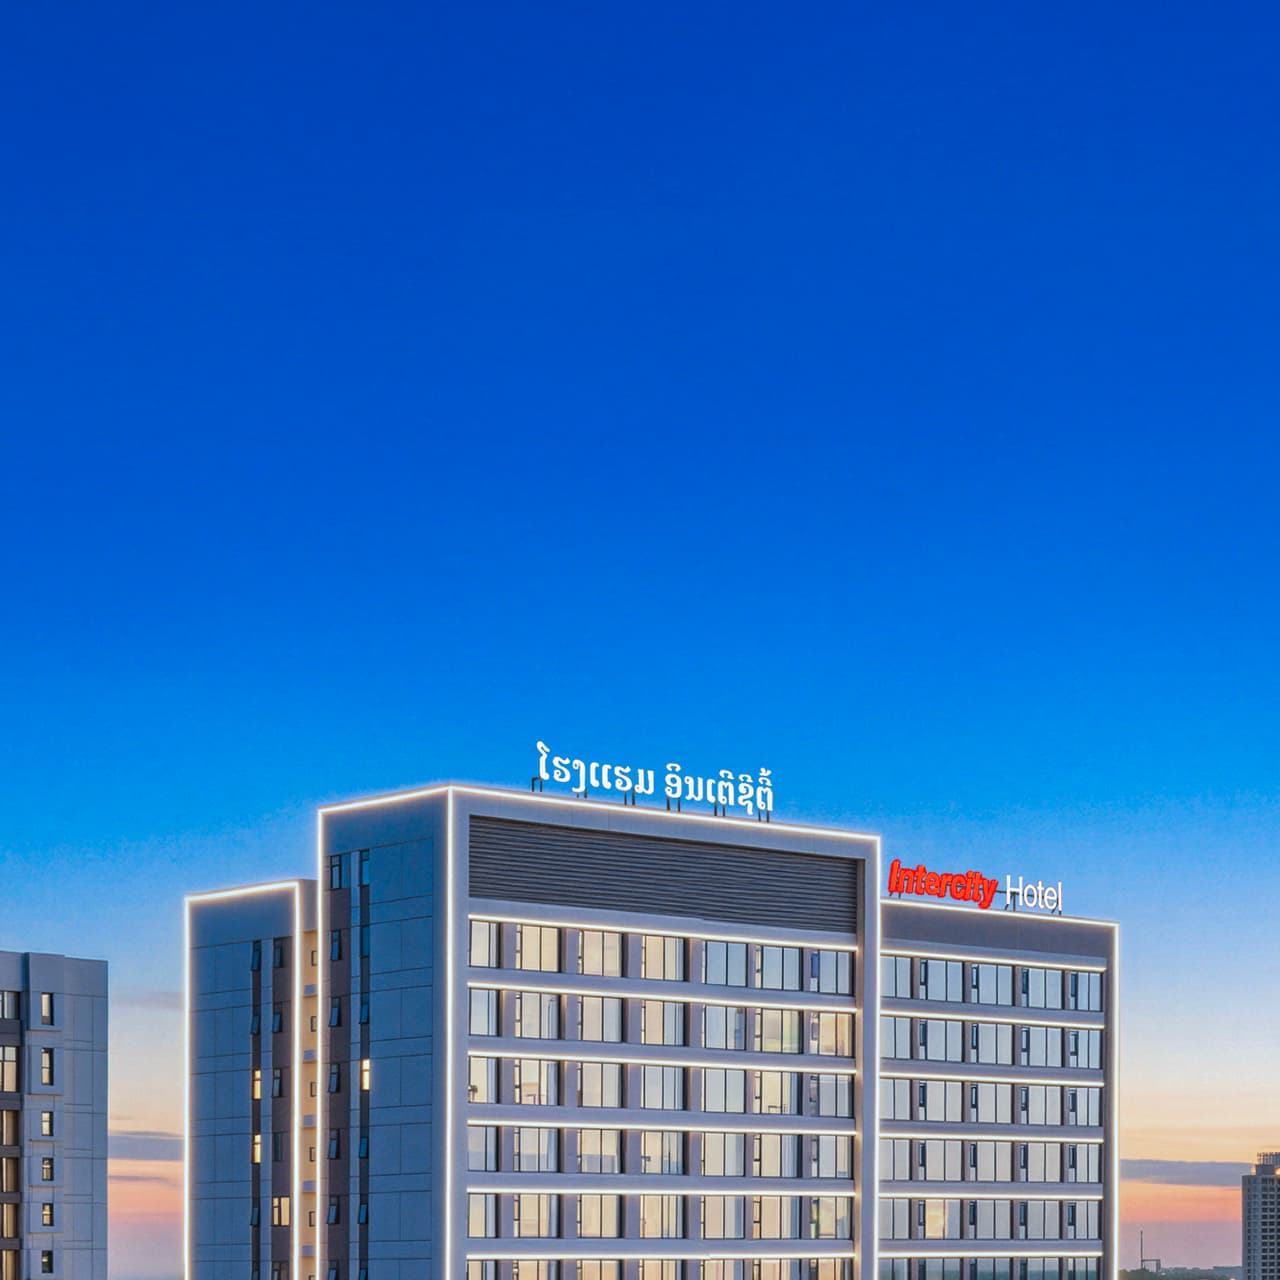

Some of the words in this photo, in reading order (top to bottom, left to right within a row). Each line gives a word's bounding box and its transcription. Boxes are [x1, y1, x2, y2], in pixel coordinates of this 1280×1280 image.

[536, 741, 655, 795] ໂຮງແຮມ
[888, 859, 998, 909] Intercity
[1006, 875, 1062, 911] Hotel
